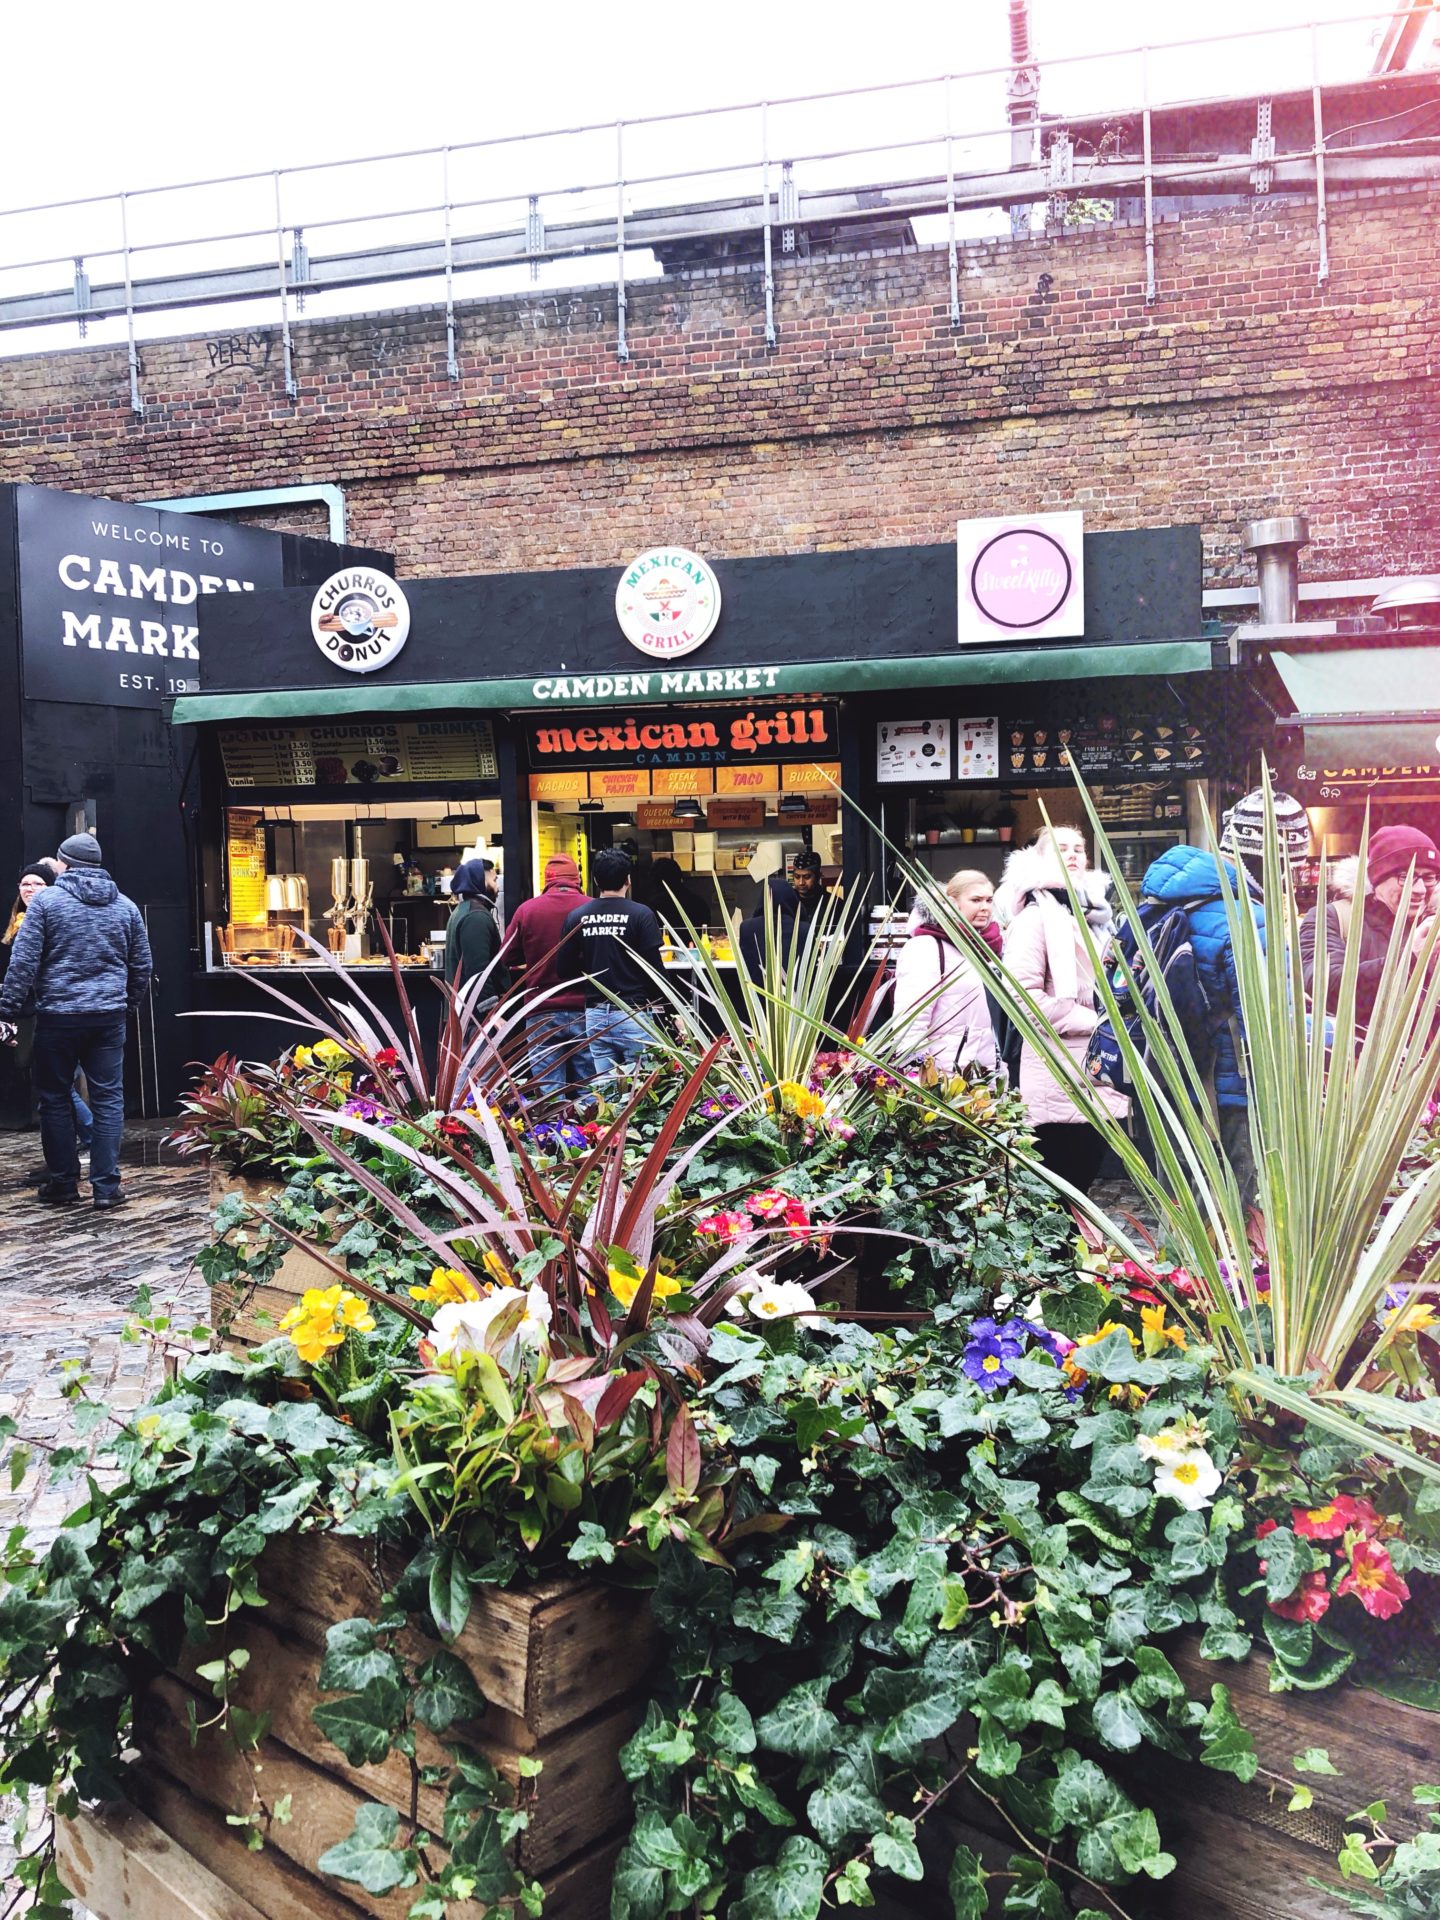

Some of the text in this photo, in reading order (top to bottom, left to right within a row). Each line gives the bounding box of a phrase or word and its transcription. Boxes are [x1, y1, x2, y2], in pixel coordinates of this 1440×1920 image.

[92, 521, 223, 556] WELCOME TO
[626, 555, 705, 588] MEXICAN
[319, 574, 395, 610] CHURROS
[62, 611, 200, 660] MARK
[642, 630, 694, 649] GRILL
[326, 629, 391, 662] DONUT
[120, 674, 187, 692] EST. 19
[532, 667, 780, 699] CAMDEN MARKET
[310, 726, 397, 739] CHURROS
[417, 721, 487, 735] DRINKS
[536, 709, 829, 753] mexican grill
[636, 751, 728, 764] CAMDEN
[602, 773, 638, 785] CHICKEN
[668, 772, 697, 782] STEAK
[733, 772, 764, 785] TACO
[789, 770, 838, 783] BURRITO
[537, 779, 579, 792] NACHOS
[605, 783, 635, 794] FAJITA
[667, 781, 698, 791] FAJITA
[643, 808, 673, 817] QUESAD
[646, 818, 684, 826] VEGETARIAN
[581, 914, 629, 924] CAMDEN
[582, 926, 626, 937] MARKET
